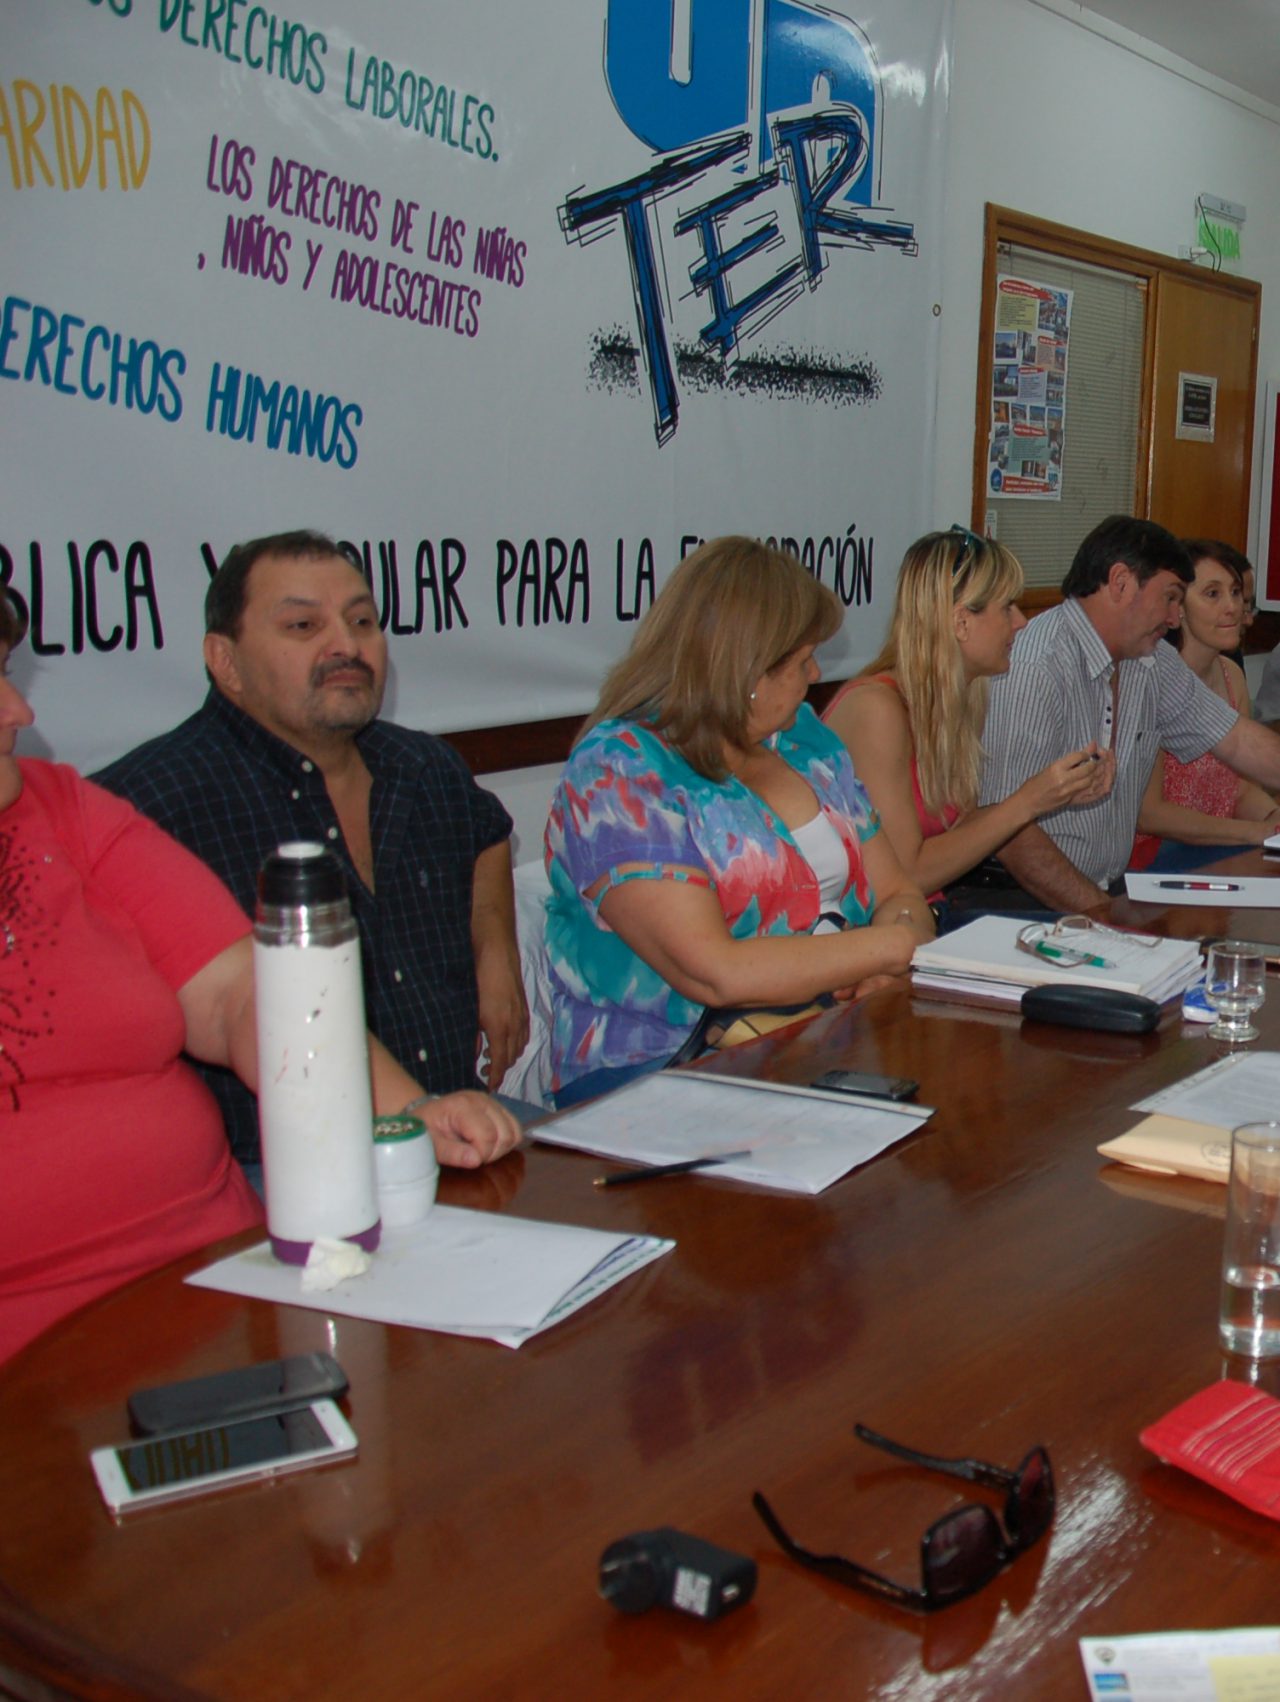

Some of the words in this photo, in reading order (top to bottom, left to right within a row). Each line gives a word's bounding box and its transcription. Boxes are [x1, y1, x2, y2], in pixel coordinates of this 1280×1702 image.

[0, 78, 152, 192] ARIDAD
[345, 46, 499, 162] LABORALES.
[206, 134, 256, 202] LOS
[267, 156, 382, 242] DERECHOS
[391, 198, 420, 254] DE
[427, 210, 466, 269] LAS
[473, 226, 527, 288] NIÑAS
[221, 213, 292, 285] NIÑOS
[302, 239, 324, 291] Y
[330, 249, 482, 338] ADOLESCENTES
[206, 362, 363, 470] HUMANOS
[336, 539, 469, 636] ULAR
[496, 538, 591, 627] PARA
[616, 537, 656, 621] LA
